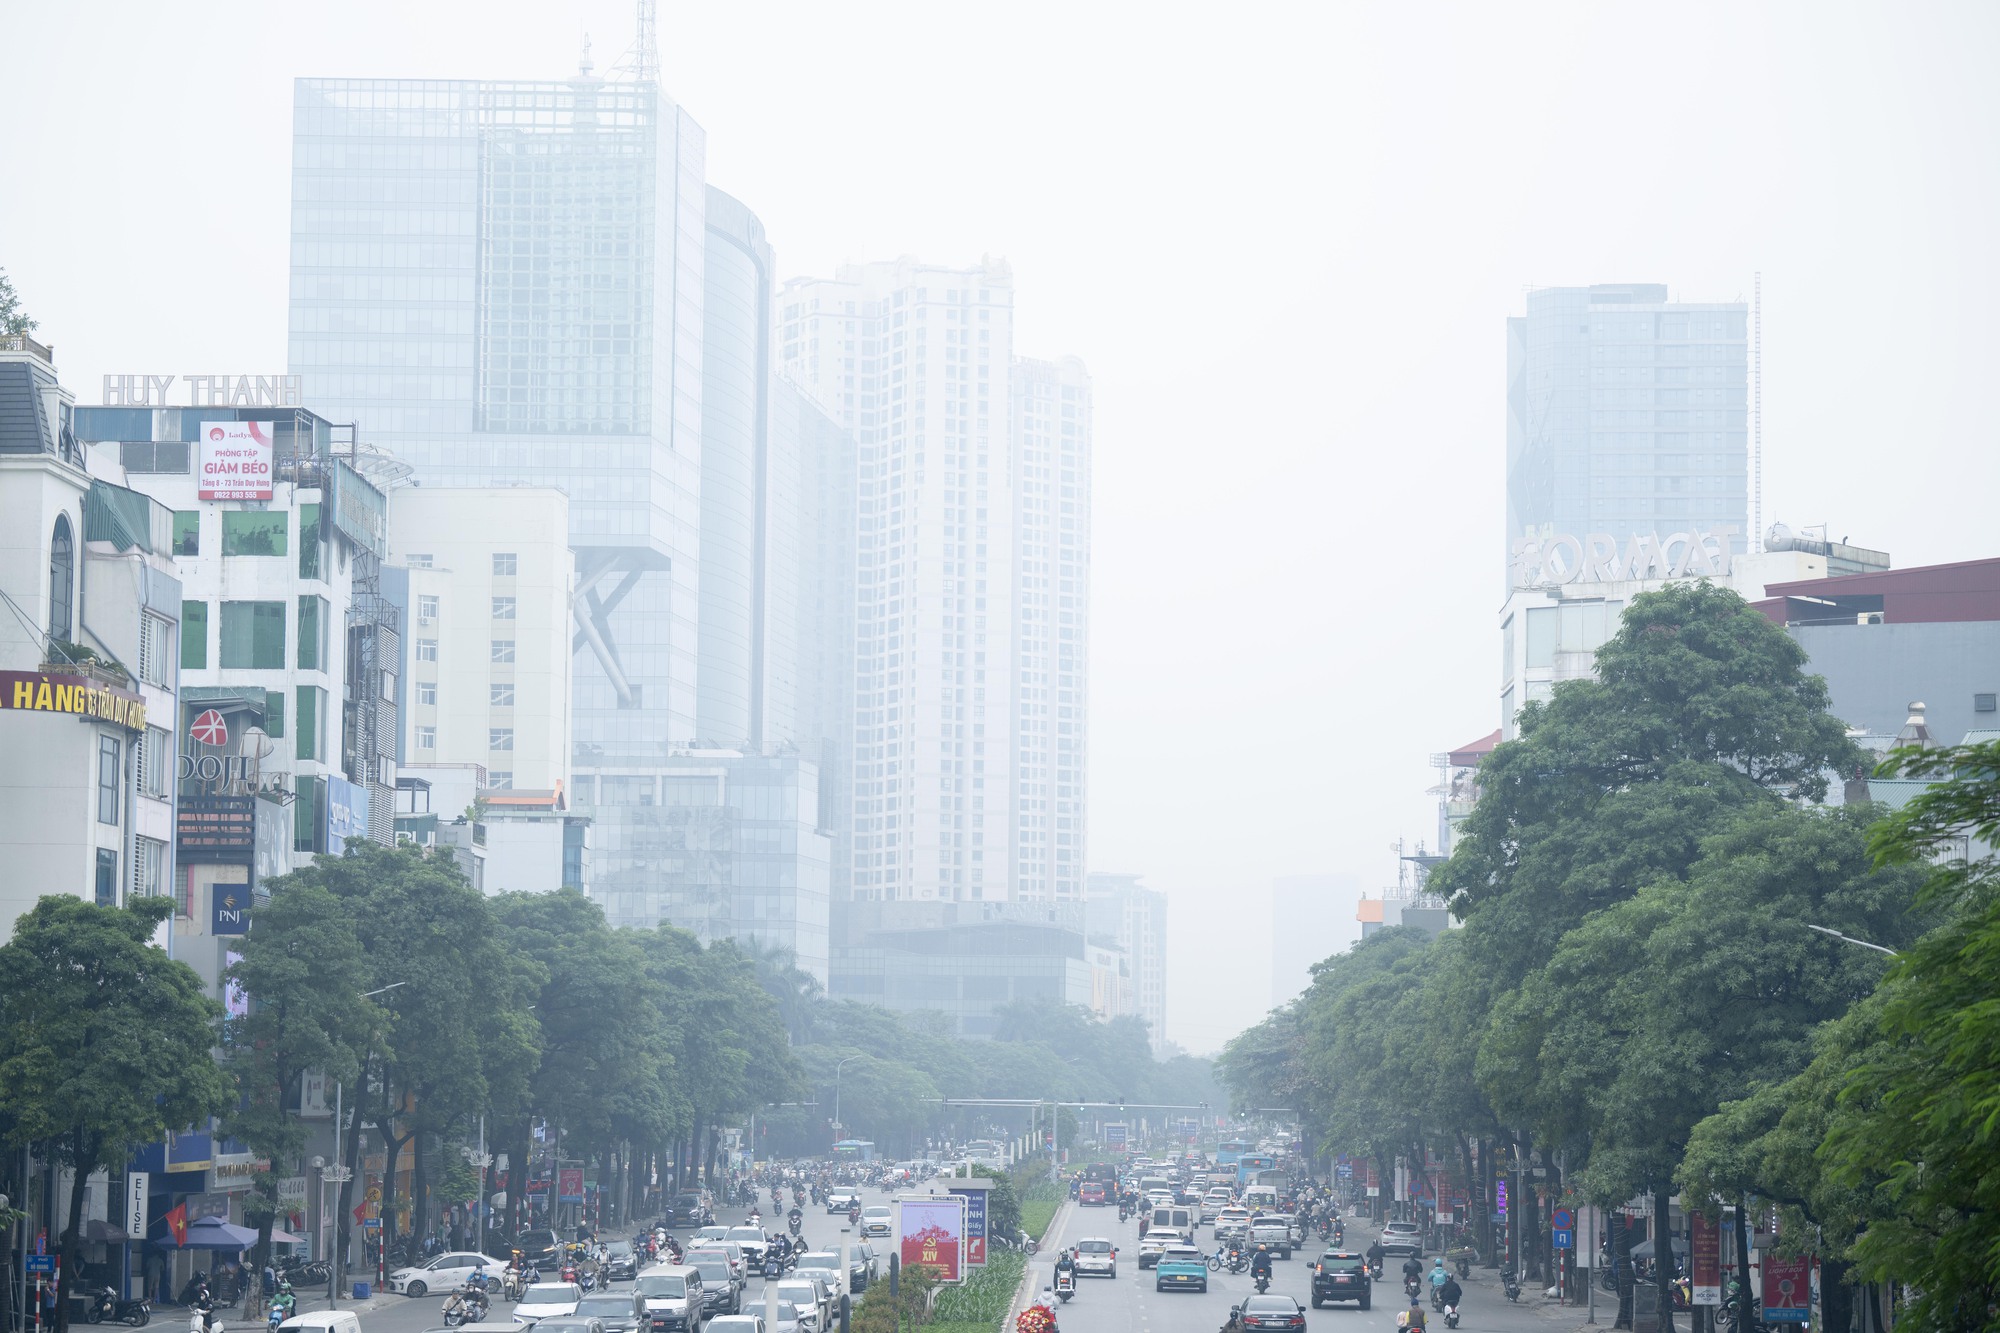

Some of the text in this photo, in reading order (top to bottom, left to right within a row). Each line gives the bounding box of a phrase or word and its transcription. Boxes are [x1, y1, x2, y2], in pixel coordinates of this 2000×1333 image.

[103, 374, 301, 406] HUY THANH
[215, 448, 257, 459] PHÒNG TẬP
[204, 459, 238, 474] GIẢM
[242, 459, 268, 474] BÉO
[245, 479, 255, 487] Duy
[214, 491, 230, 499] 0922
[245, 491, 257, 499] 555
[13, 676, 85, 713] HÀNG
[88, 687, 97, 715] 63
[114, 696, 128, 725] DUY
[218, 909, 240, 924] PNJ
[133, 1177, 142, 1234] ELISE
[922, 1251, 938, 1261] XIV
